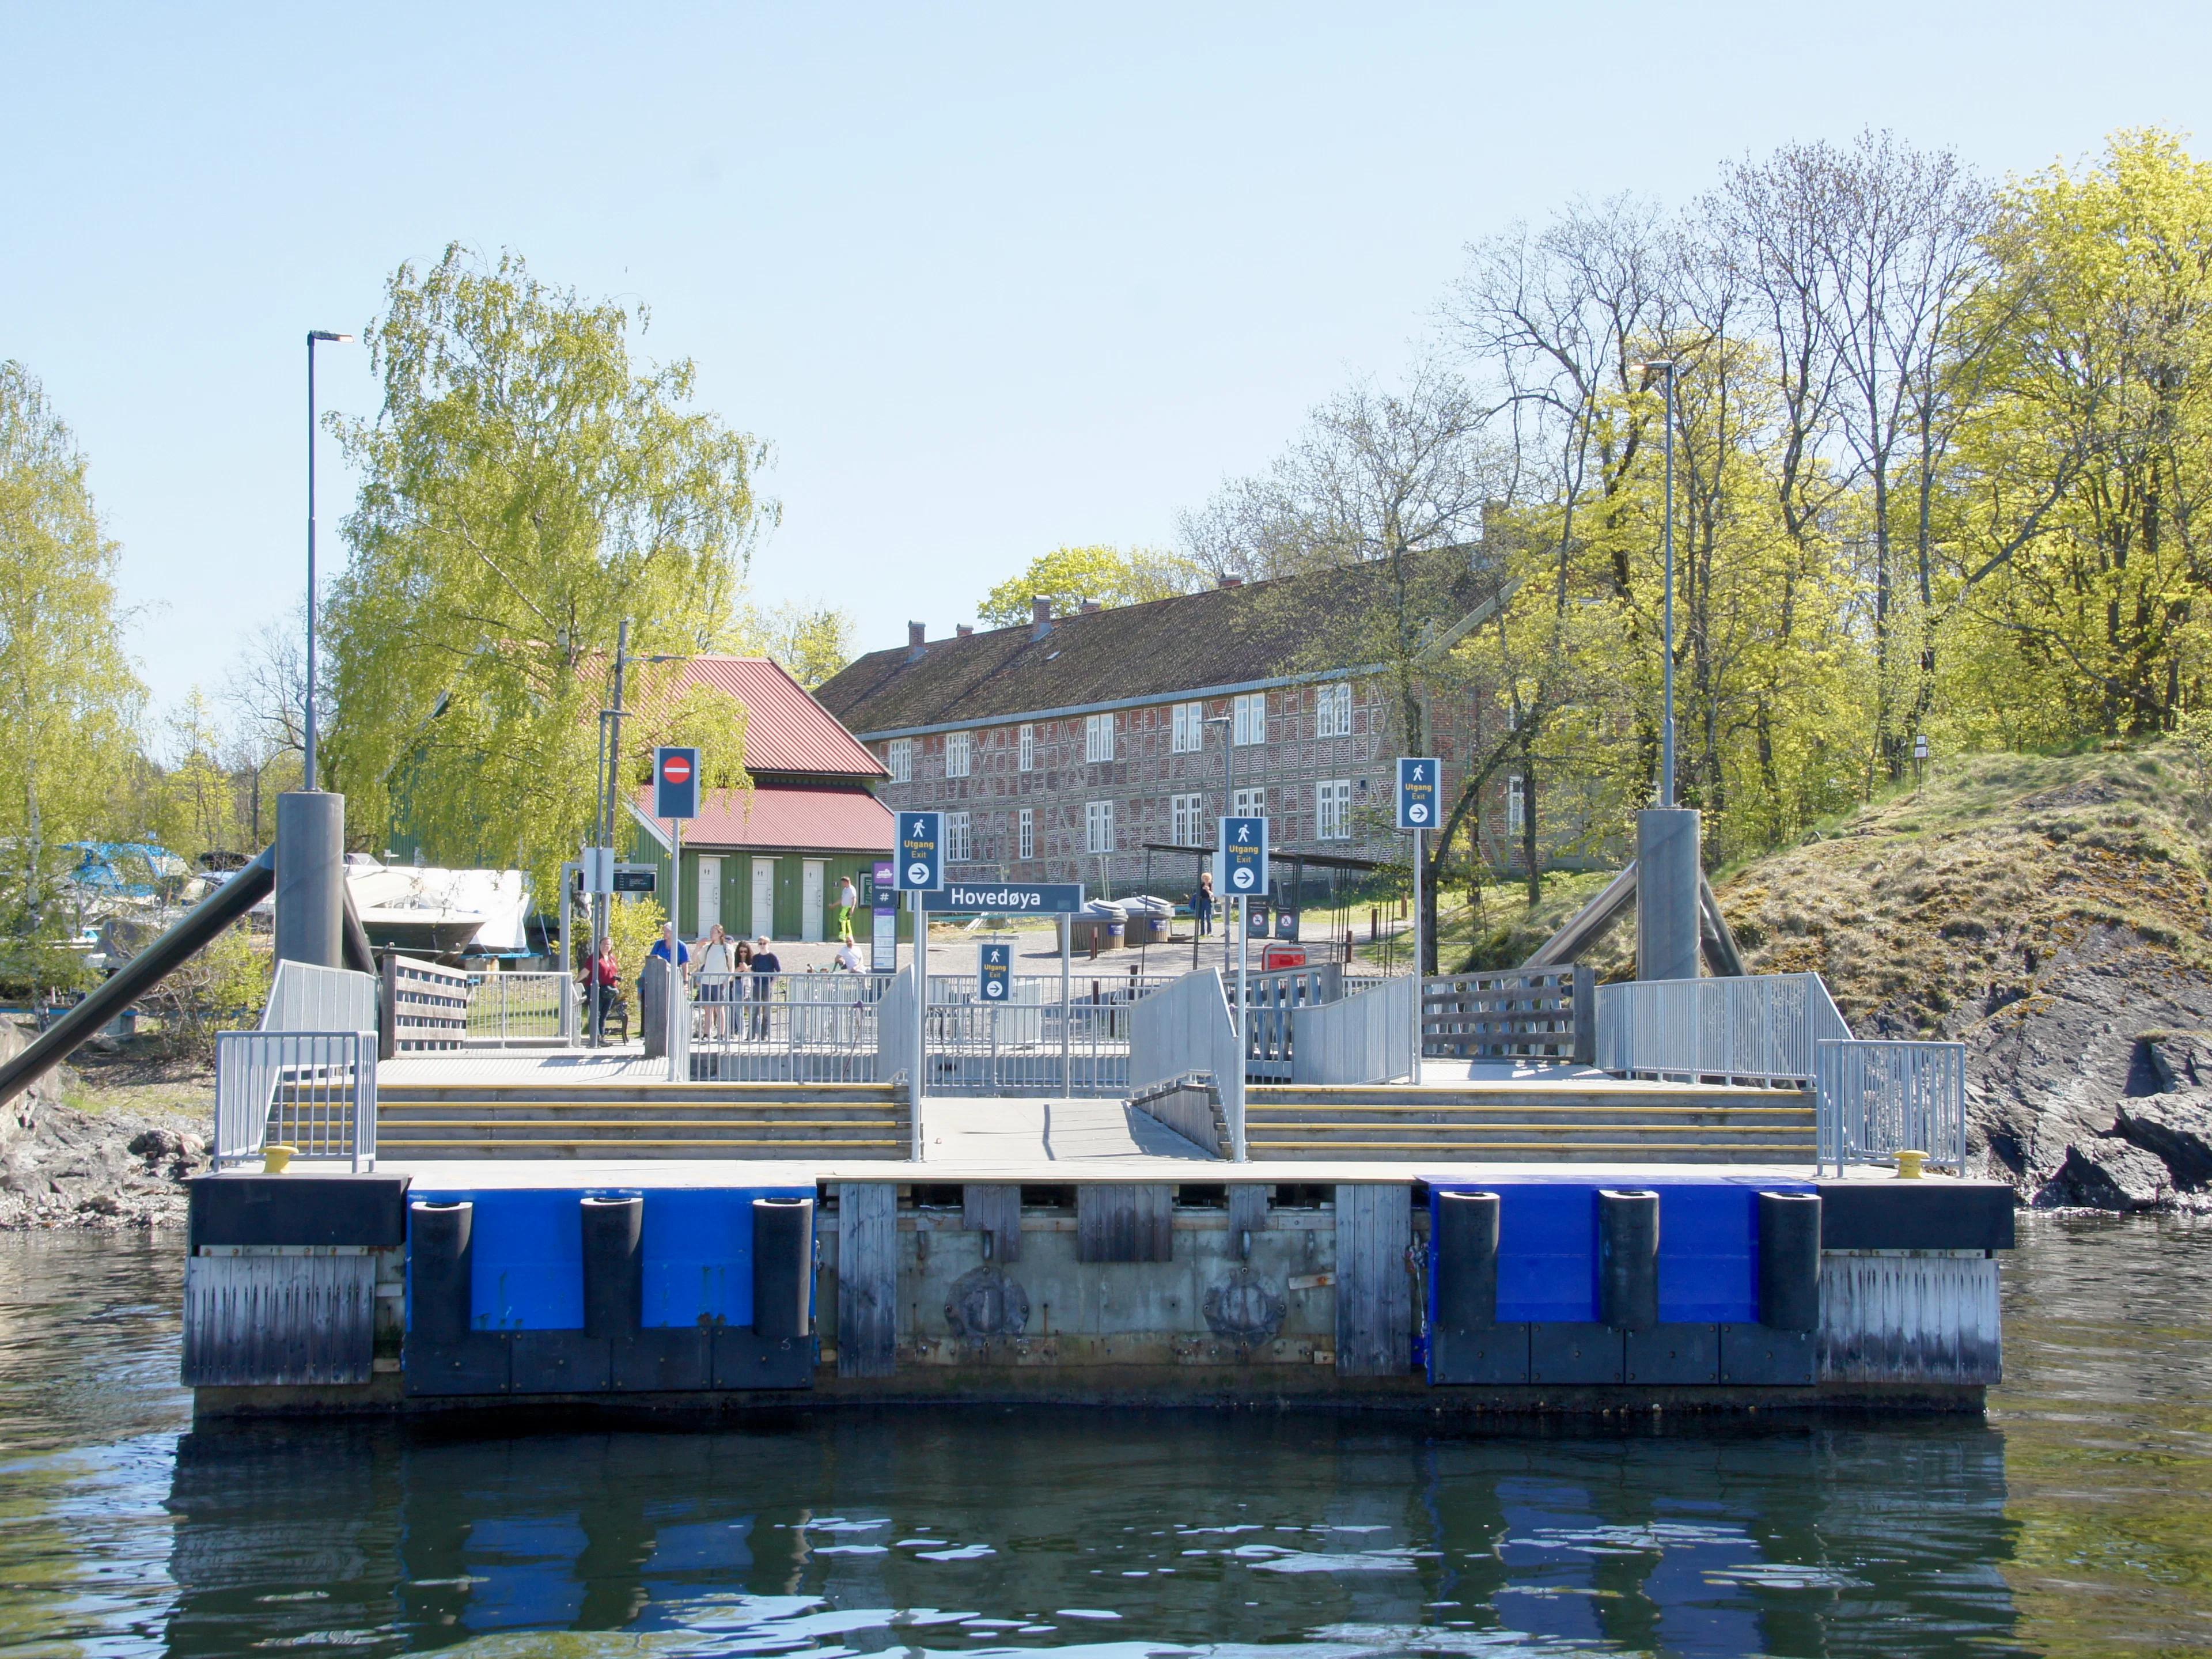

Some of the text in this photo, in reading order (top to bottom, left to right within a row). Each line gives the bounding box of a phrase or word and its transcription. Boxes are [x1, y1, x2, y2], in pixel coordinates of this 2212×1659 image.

[1405, 783, 1432, 792] Utgang
[904, 840, 934, 850] Utgang
[1229, 845, 1259, 854] Utgang
[911, 850, 926, 858] Exit
[1236, 855, 1251, 863] Exit
[951, 888, 1041, 909] Hovedøya
[984, 964, 1006, 972] Utgang
